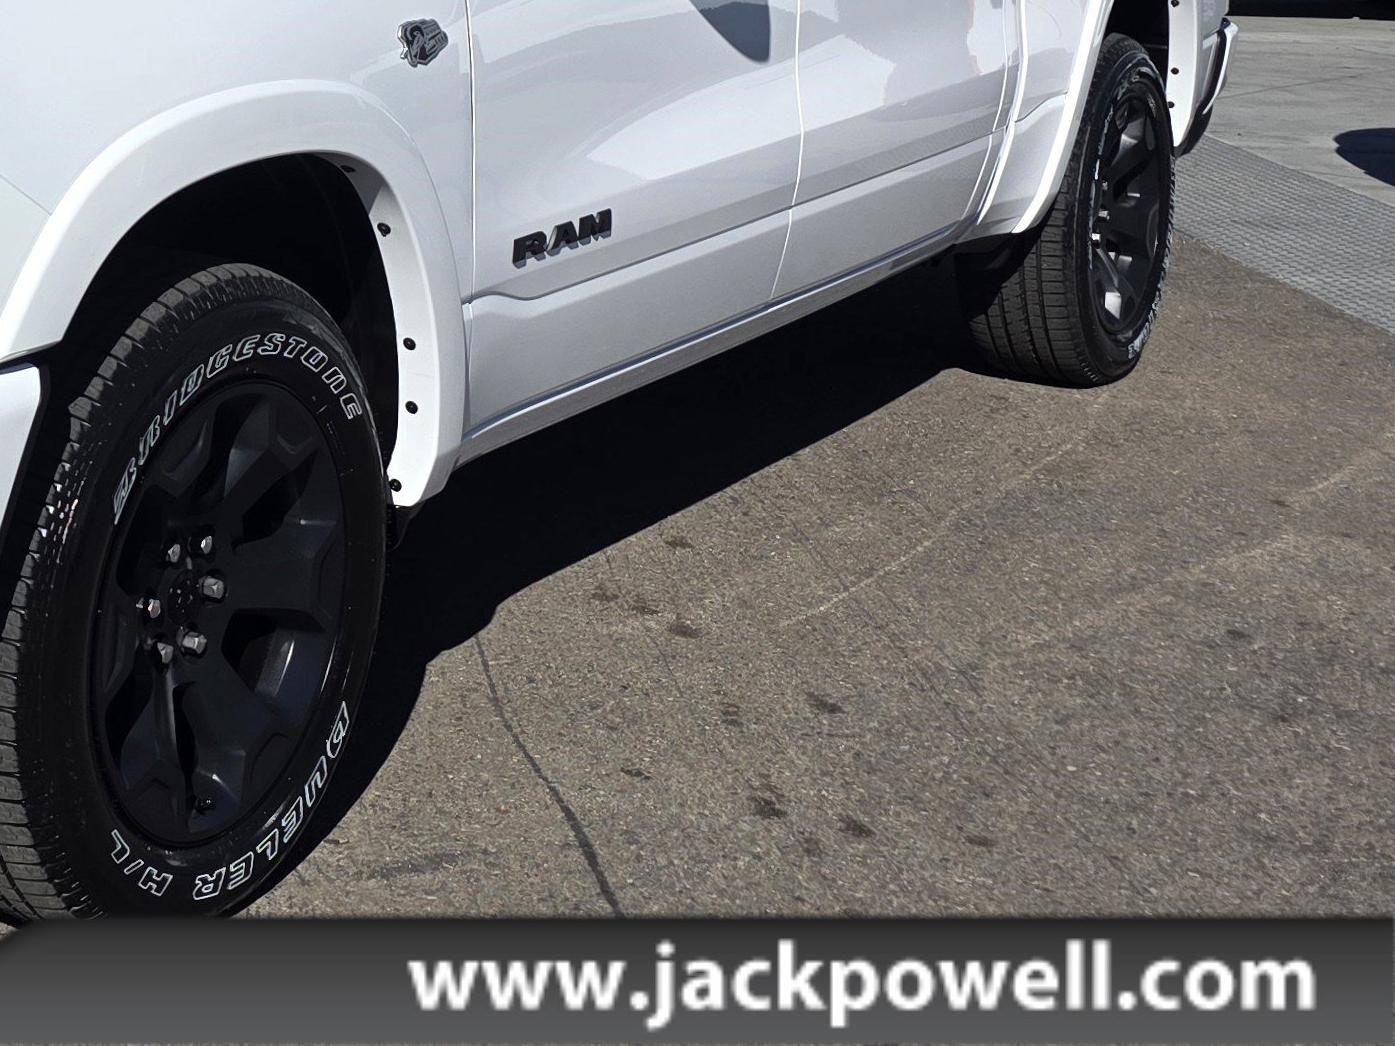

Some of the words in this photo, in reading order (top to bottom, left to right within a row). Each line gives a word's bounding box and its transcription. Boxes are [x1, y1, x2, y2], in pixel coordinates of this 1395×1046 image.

[512, 208, 612, 269] RAM
[113, 333, 363, 525] BRIDGESTONE
[110, 829, 174, 897] H/L
[192, 700, 350, 901] DUELER
